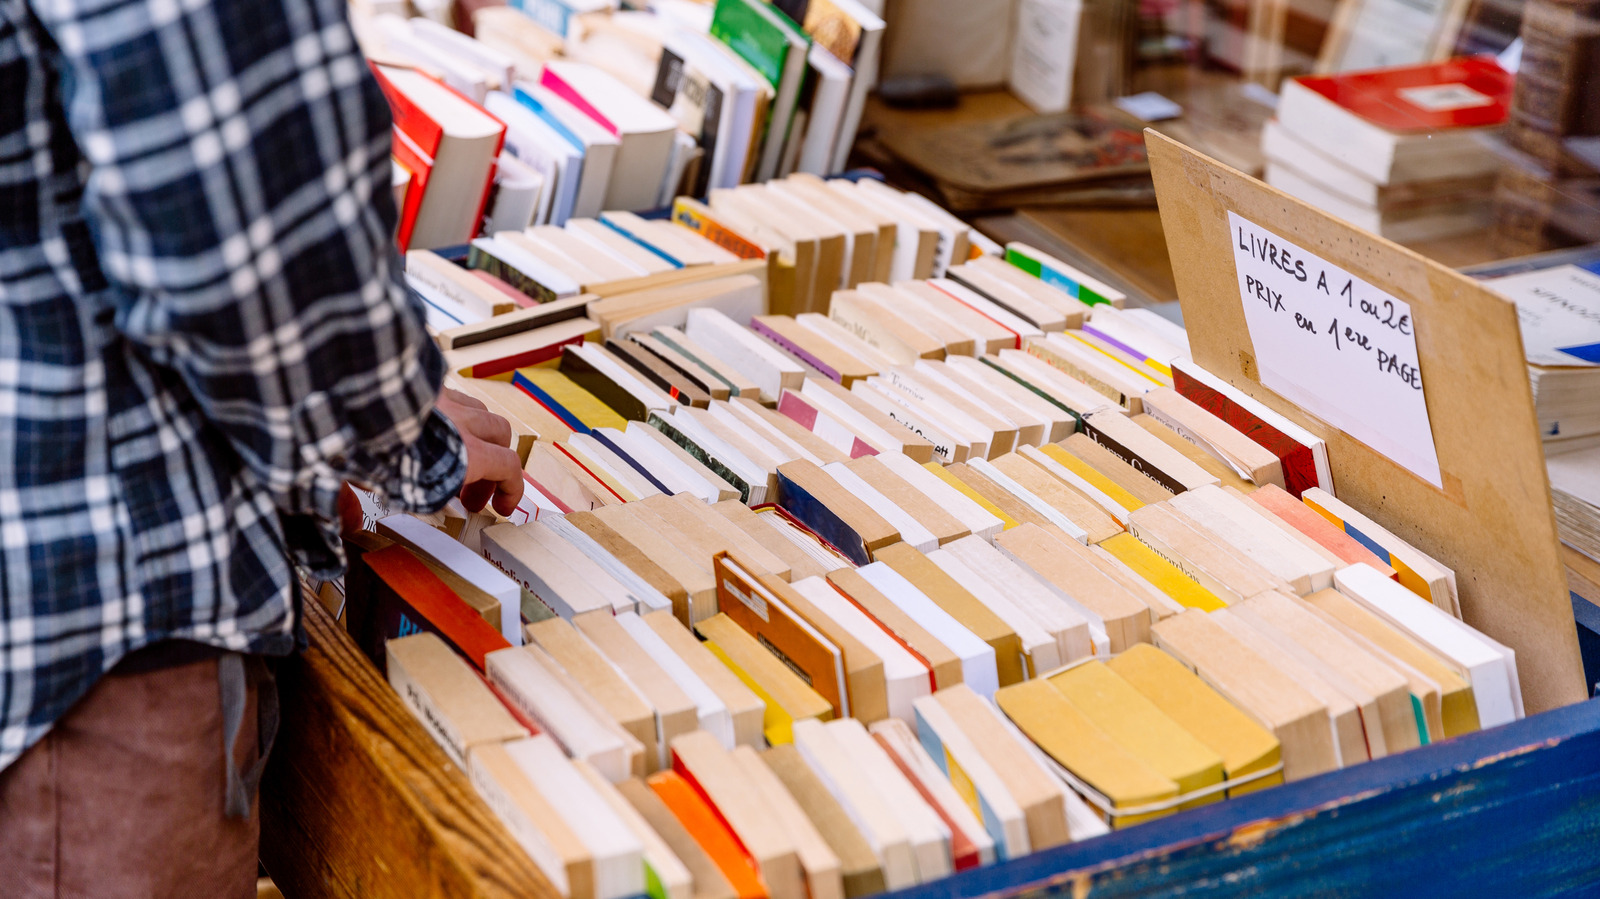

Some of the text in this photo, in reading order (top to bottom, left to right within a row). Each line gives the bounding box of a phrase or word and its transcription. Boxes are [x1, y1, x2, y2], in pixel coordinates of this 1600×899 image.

[1238, 226, 1307, 282] LIVRES
[1316, 270, 1330, 296] A
[1341, 278, 1353, 308] 1
[1245, 273, 1287, 313] PRIX
[1294, 310, 1317, 335] en
[1376, 347, 1422, 391] PAGE
